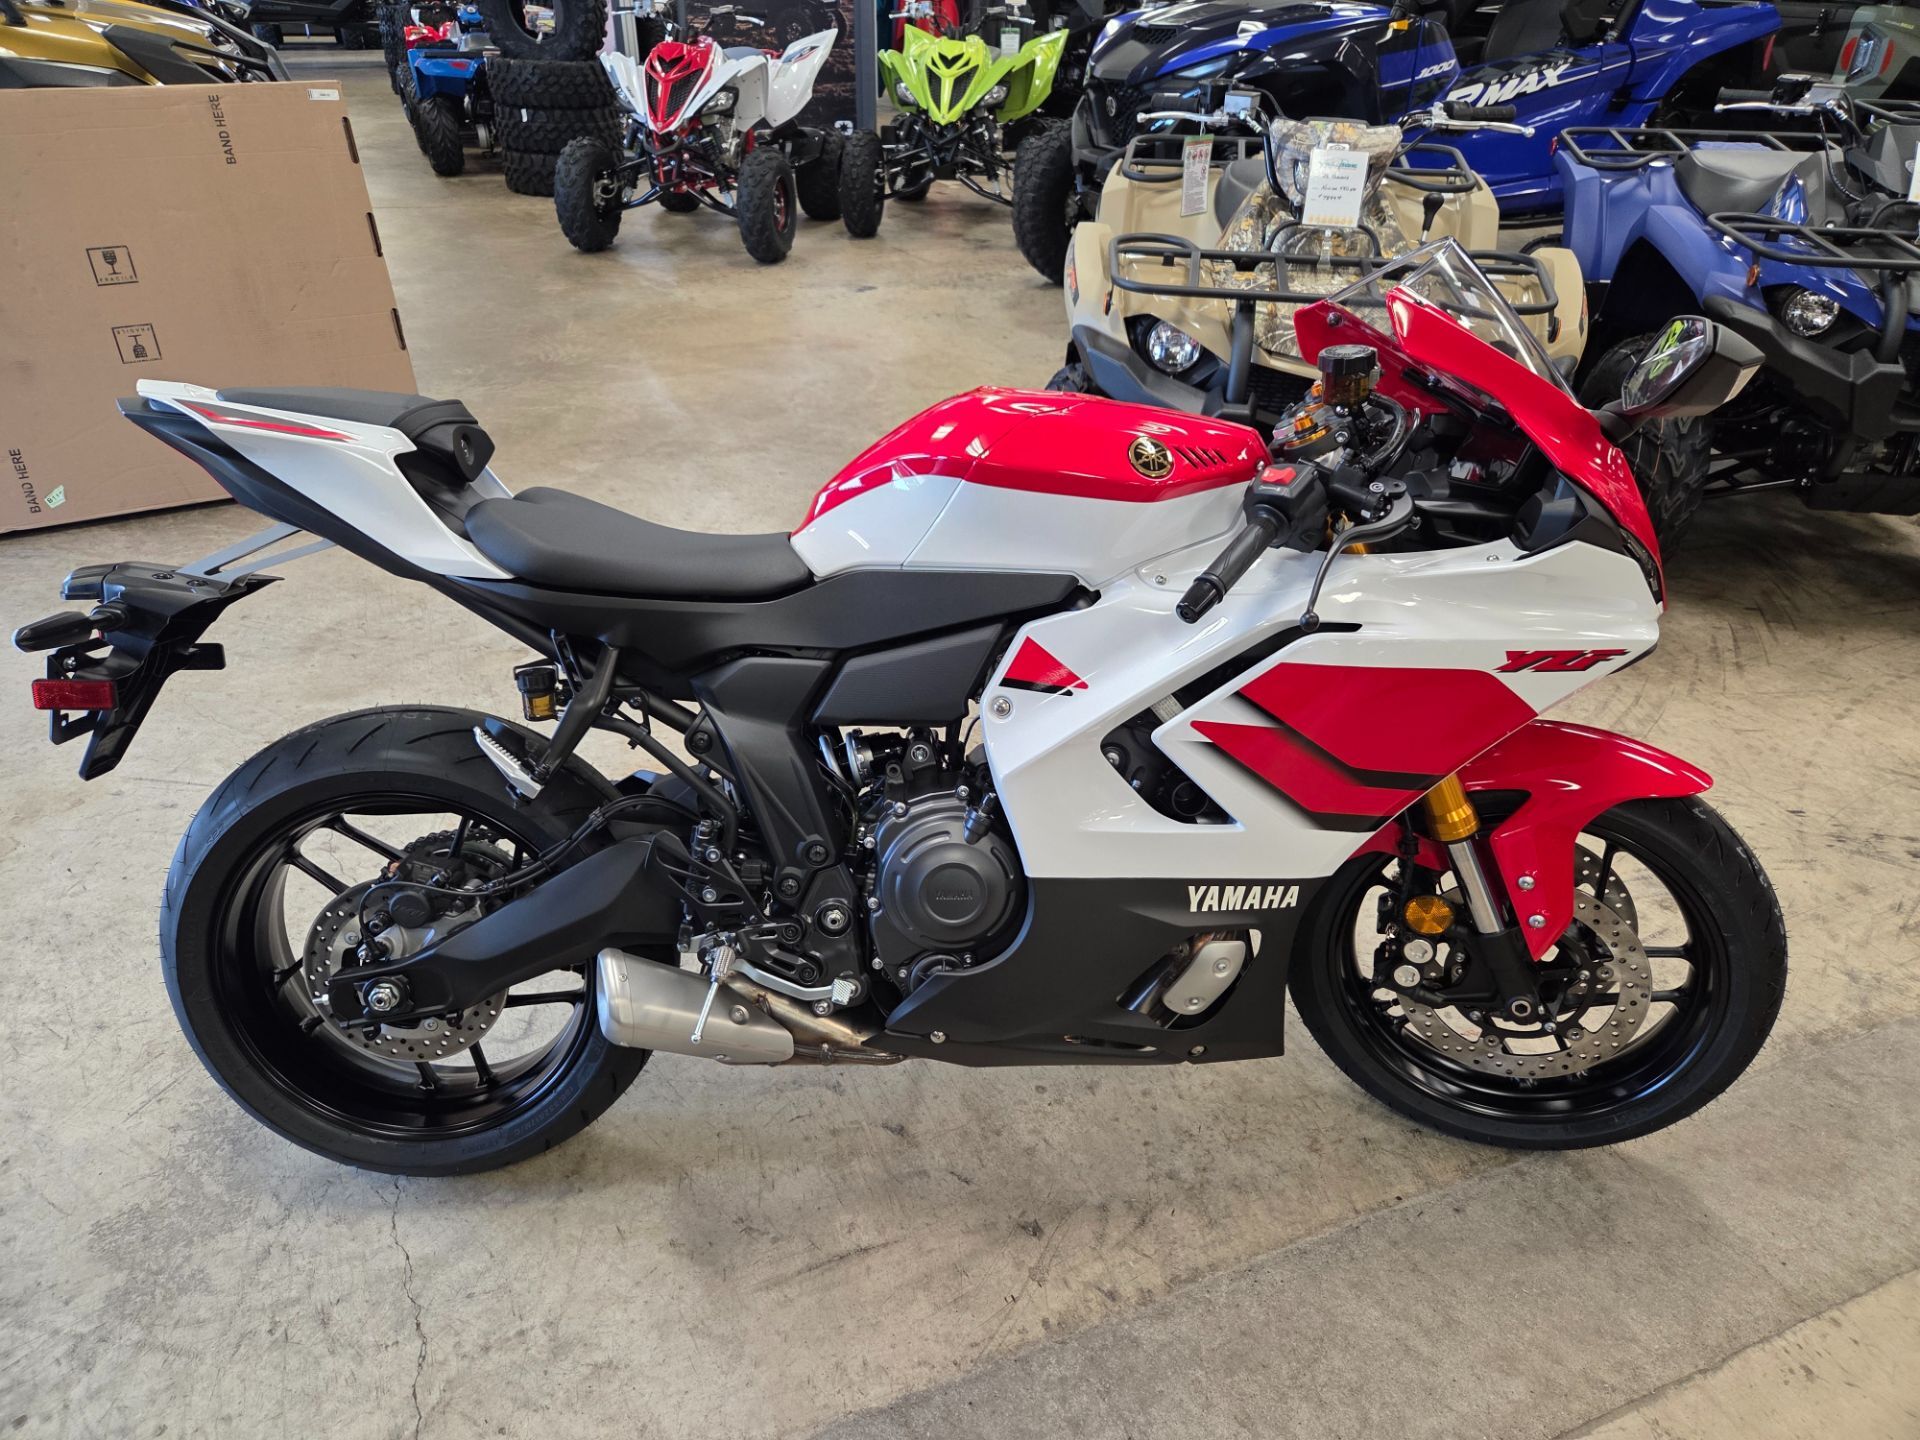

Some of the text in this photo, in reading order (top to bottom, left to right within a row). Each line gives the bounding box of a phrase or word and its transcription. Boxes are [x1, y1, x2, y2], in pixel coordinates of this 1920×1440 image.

[1419, 59, 1457, 79] 1000
[208, 93, 237, 165] BAND HERE
[8, 448, 42, 514] BAND HERE
[1491, 648, 1632, 674] YZF
[1187, 885, 1300, 913] YAMAHA
